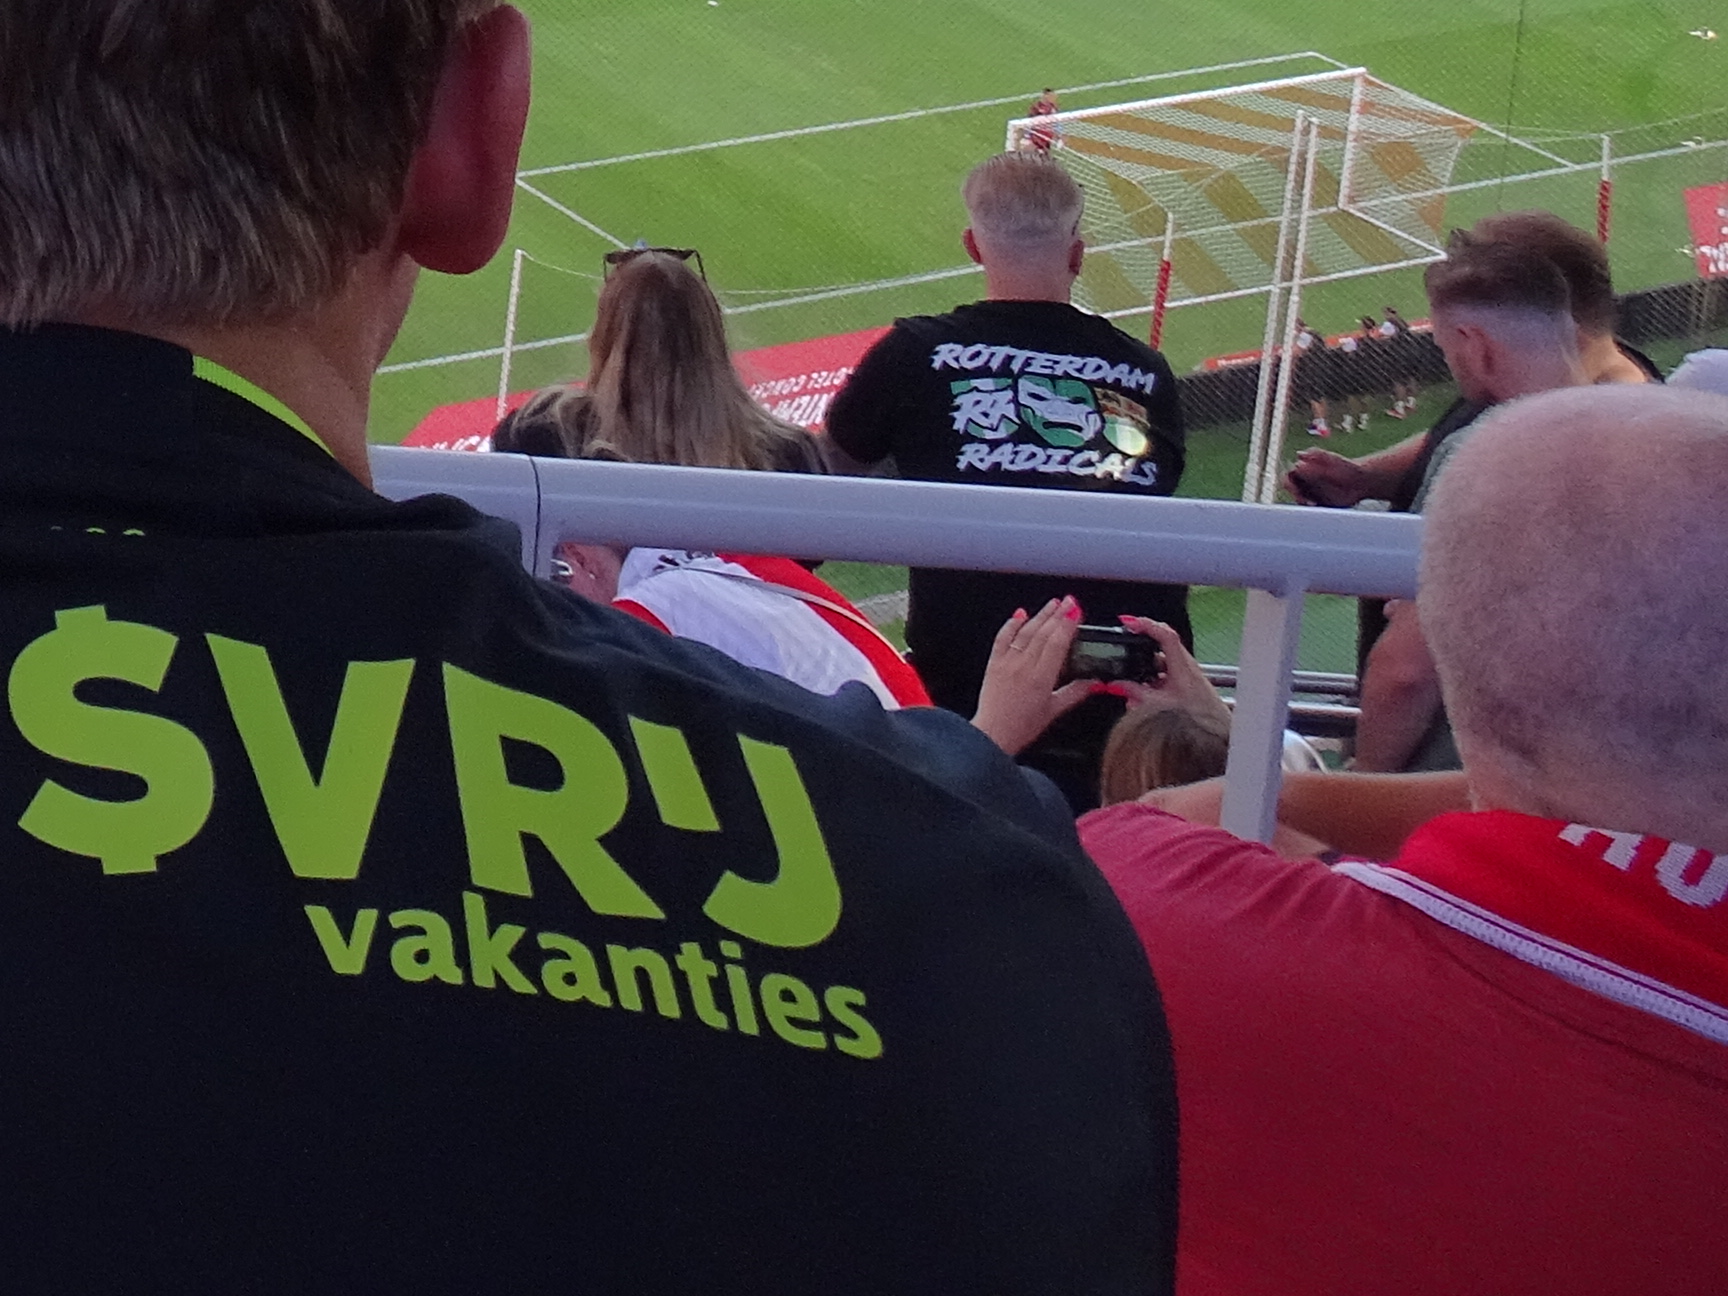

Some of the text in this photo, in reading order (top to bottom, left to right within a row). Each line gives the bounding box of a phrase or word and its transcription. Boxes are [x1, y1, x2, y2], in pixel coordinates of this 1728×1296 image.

[931, 342, 1155, 393] ROTTERDAM
[957, 442, 1155, 485] RADICALS
[300, 889, 887, 1062] vakanties
